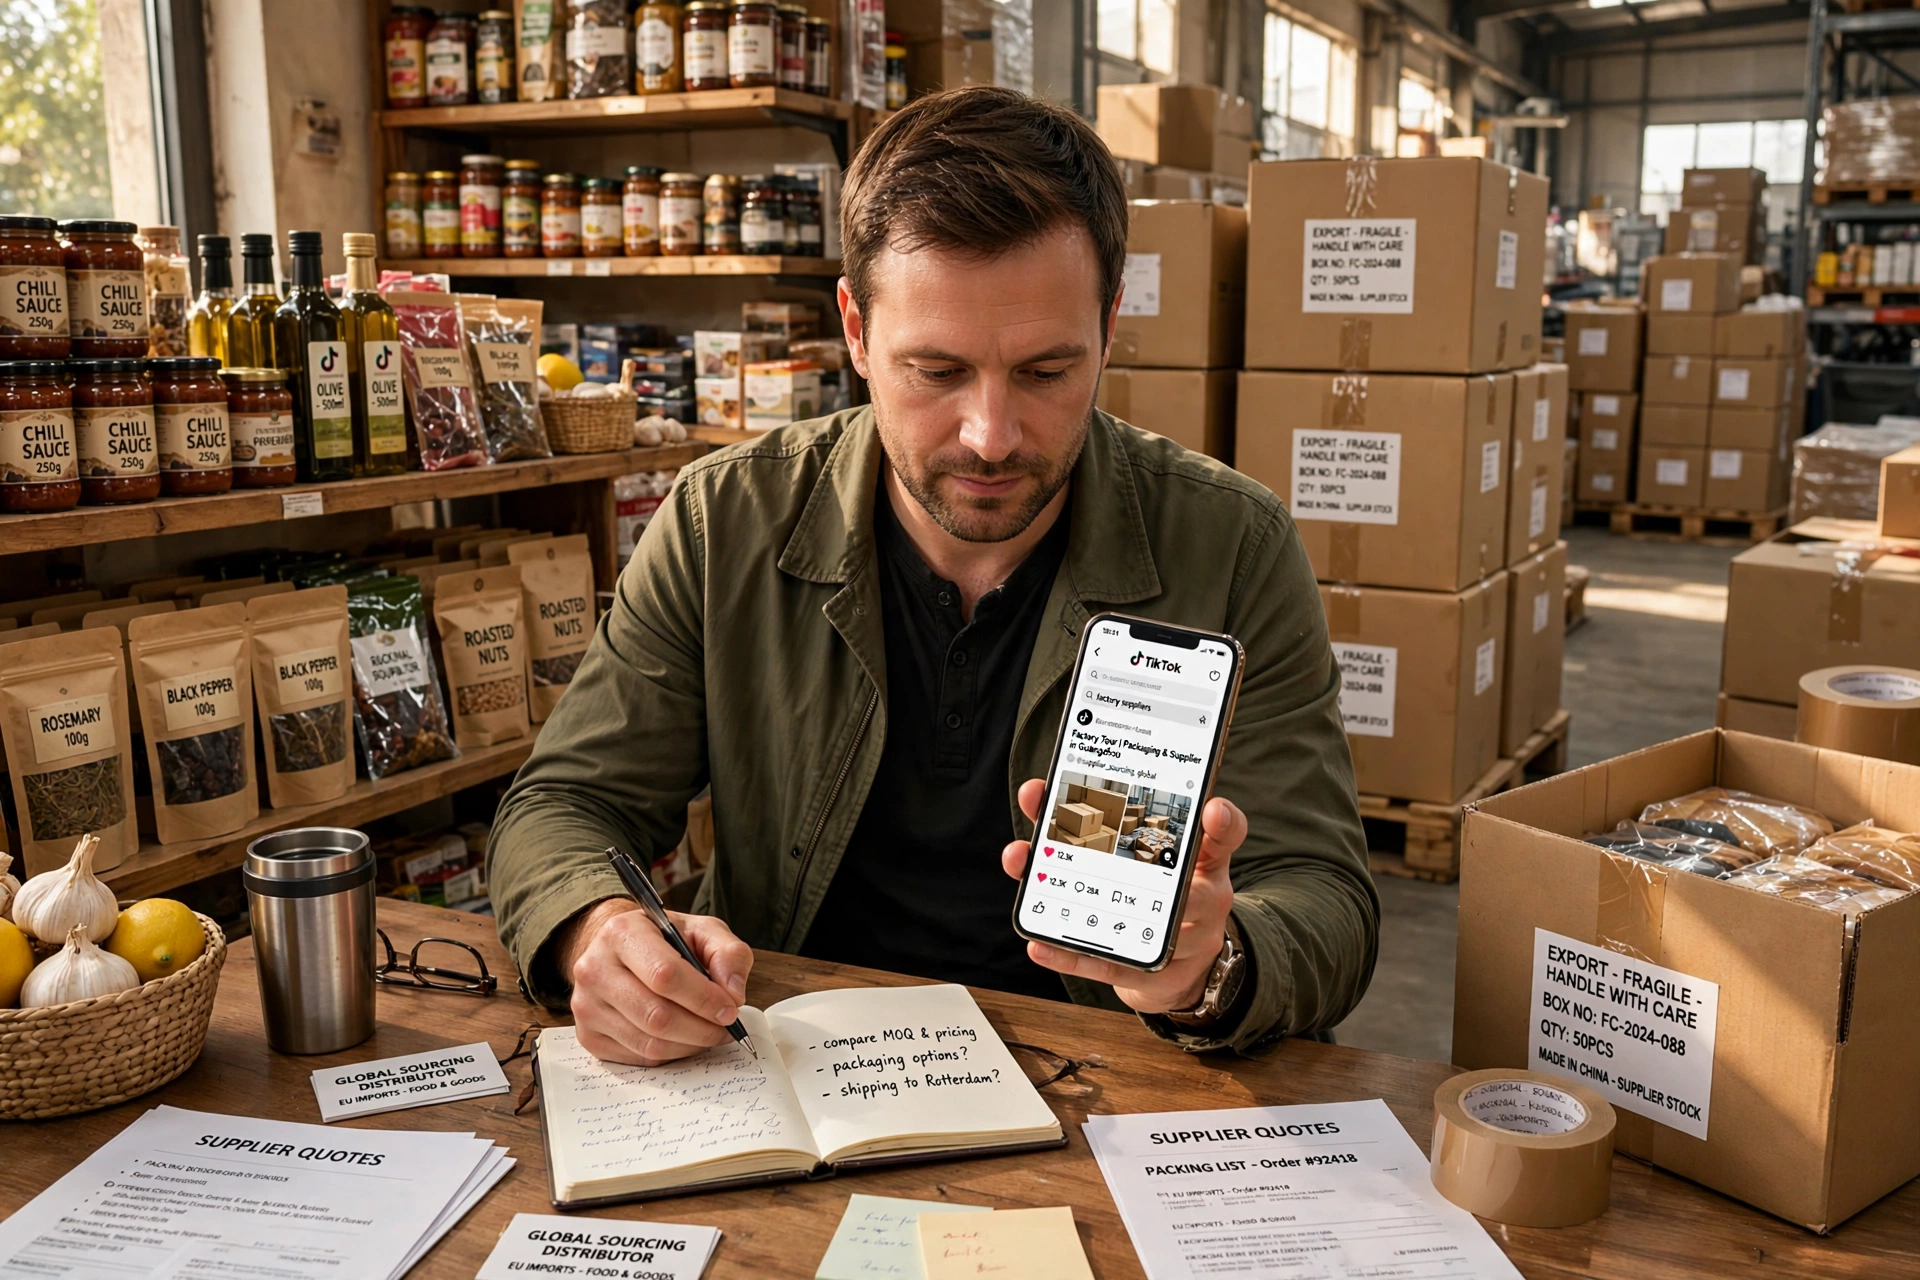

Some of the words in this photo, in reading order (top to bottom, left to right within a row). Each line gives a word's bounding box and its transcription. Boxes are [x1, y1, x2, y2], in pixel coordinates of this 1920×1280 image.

[1313, 227, 1351, 237] EXPORT
[1360, 227, 1402, 237] FRAGILE
[1312, 241, 1349, 251] HANDLE
[1352, 241, 1376, 251] WITH
[1378, 241, 1403, 251] CARE
[1311, 259, 1328, 268] BOX
[17, 281, 56, 296] CHILI
[101, 285, 138, 300] CHILI
[16, 298, 62, 313] SAUCE
[100, 302, 143, 316] SAUCE
[29, 317, 53, 330] 250g
[112, 320, 135, 332] 250g
[317, 382, 344, 396] OLIVE
[372, 380, 397, 394] OLIVE
[22, 424, 64, 441] CHILI
[108, 421, 147, 438] CHILI
[187, 417, 222, 432] CHILI
[108, 438, 152, 454] SAUCE
[187, 433, 226, 449] SAUCE
[1301, 437, 1337, 449] EXPORT
[1347, 439, 1386, 450] FRAGILE
[23, 441, 70, 459] SAUCE
[198, 452, 220, 463] 250g
[1300, 451, 1336, 462] HANDLE
[1339, 452, 1362, 463] WITH
[1364, 453, 1389, 464] CARE
[36, 462, 61, 474] 250g
[121, 457, 144, 469] 250g
[1299, 467, 1315, 477] BOX
[540, 597, 586, 620] ROASTED
[464, 623, 514, 647] ROASTED
[554, 621, 582, 638] NUTS
[478, 646, 509, 666] NUTS
[1342, 651, 1383, 664] FRAGILE
[279, 662, 308, 681] BLACK
[309, 656, 338, 675] PEPPER
[1145, 656, 1182, 674] TikTok
[1361, 665, 1384, 678] CARE
[166, 685, 199, 704] BLACK
[200, 678, 234, 696] PEPPER
[304, 677, 324, 693] 100g
[1096, 693, 1120, 707] factory
[194, 702, 216, 717] 100g
[41, 707, 101, 733] ROSEMARY
[64, 731, 89, 747] 100g
[1072, 729, 1099, 744] Factory
[1548, 944, 1609, 977] EXPORT
[1623, 968, 1691, 1005] FRAGILE
[1546, 965, 1605, 999] HANDLE
[1609, 986, 1648, 1013] WITH
[1653, 1001, 1697, 1029] CARE
[1543, 992, 1570, 1015] BOX
[1573, 1003, 1597, 1024] NO:
[1601, 1013, 1686, 1056] FC-2024-088
[824, 1034, 878, 1050] compare
[883, 1028, 915, 1042] MOQ
[921, 1027, 930, 1038] &
[936, 1026, 978, 1042] pricing
[1540, 1019, 1570, 1042] QTY:
[1573, 1031, 1614, 1058] 50PCS
[335, 1069, 396, 1085] GLOBAL
[400, 1055, 475, 1074] SOURCING
[833, 1054, 906, 1077] packaging
[913, 1046, 968, 1068] options?
[358, 1068, 457, 1091] DISTRIBUTOR
[841, 1081, 899, 1099] shipping
[904, 1076, 918, 1088] to
[926, 1069, 1000, 1087] Rotterdam?
[1538, 1046, 1566, 1068] MADE
[1567, 1058, 1578, 1072] IN
[1580, 1062, 1609, 1085] CHINA
[1618, 1076, 1664, 1107] SUPPLIER
[1666, 1095, 1701, 1122] STOCK
[356, 1089, 400, 1103] IMPORTS
[409, 1083, 437, 1094] FOOD
[450, 1075, 486, 1087] GOODS
[1149, 1127, 1252, 1146] SUPPLIER
[1254, 1122, 1341, 1138] QUOTES
[195, 1134, 300, 1158] SUPPLIER
[298, 1146, 386, 1167] QUOTES
[1145, 1160, 1214, 1177] PACKING
[1216, 1158, 1247, 1172] LIST
[1260, 1156, 1303, 1169] Order
[1305, 1152, 1358, 1166] #92418
[528, 1230, 593, 1244] GLOBAL
[597, 1235, 686, 1251] SOURCING
[542, 1246, 654, 1263] DISTRIBUTOR
[508, 1261, 524, 1270] EU
[525, 1262, 576, 1274] IMPORTS
[586, 1266, 619, 1278] FOOD
[620, 1270, 629, 1278] &
[633, 1271, 675, 1280] GOODS
